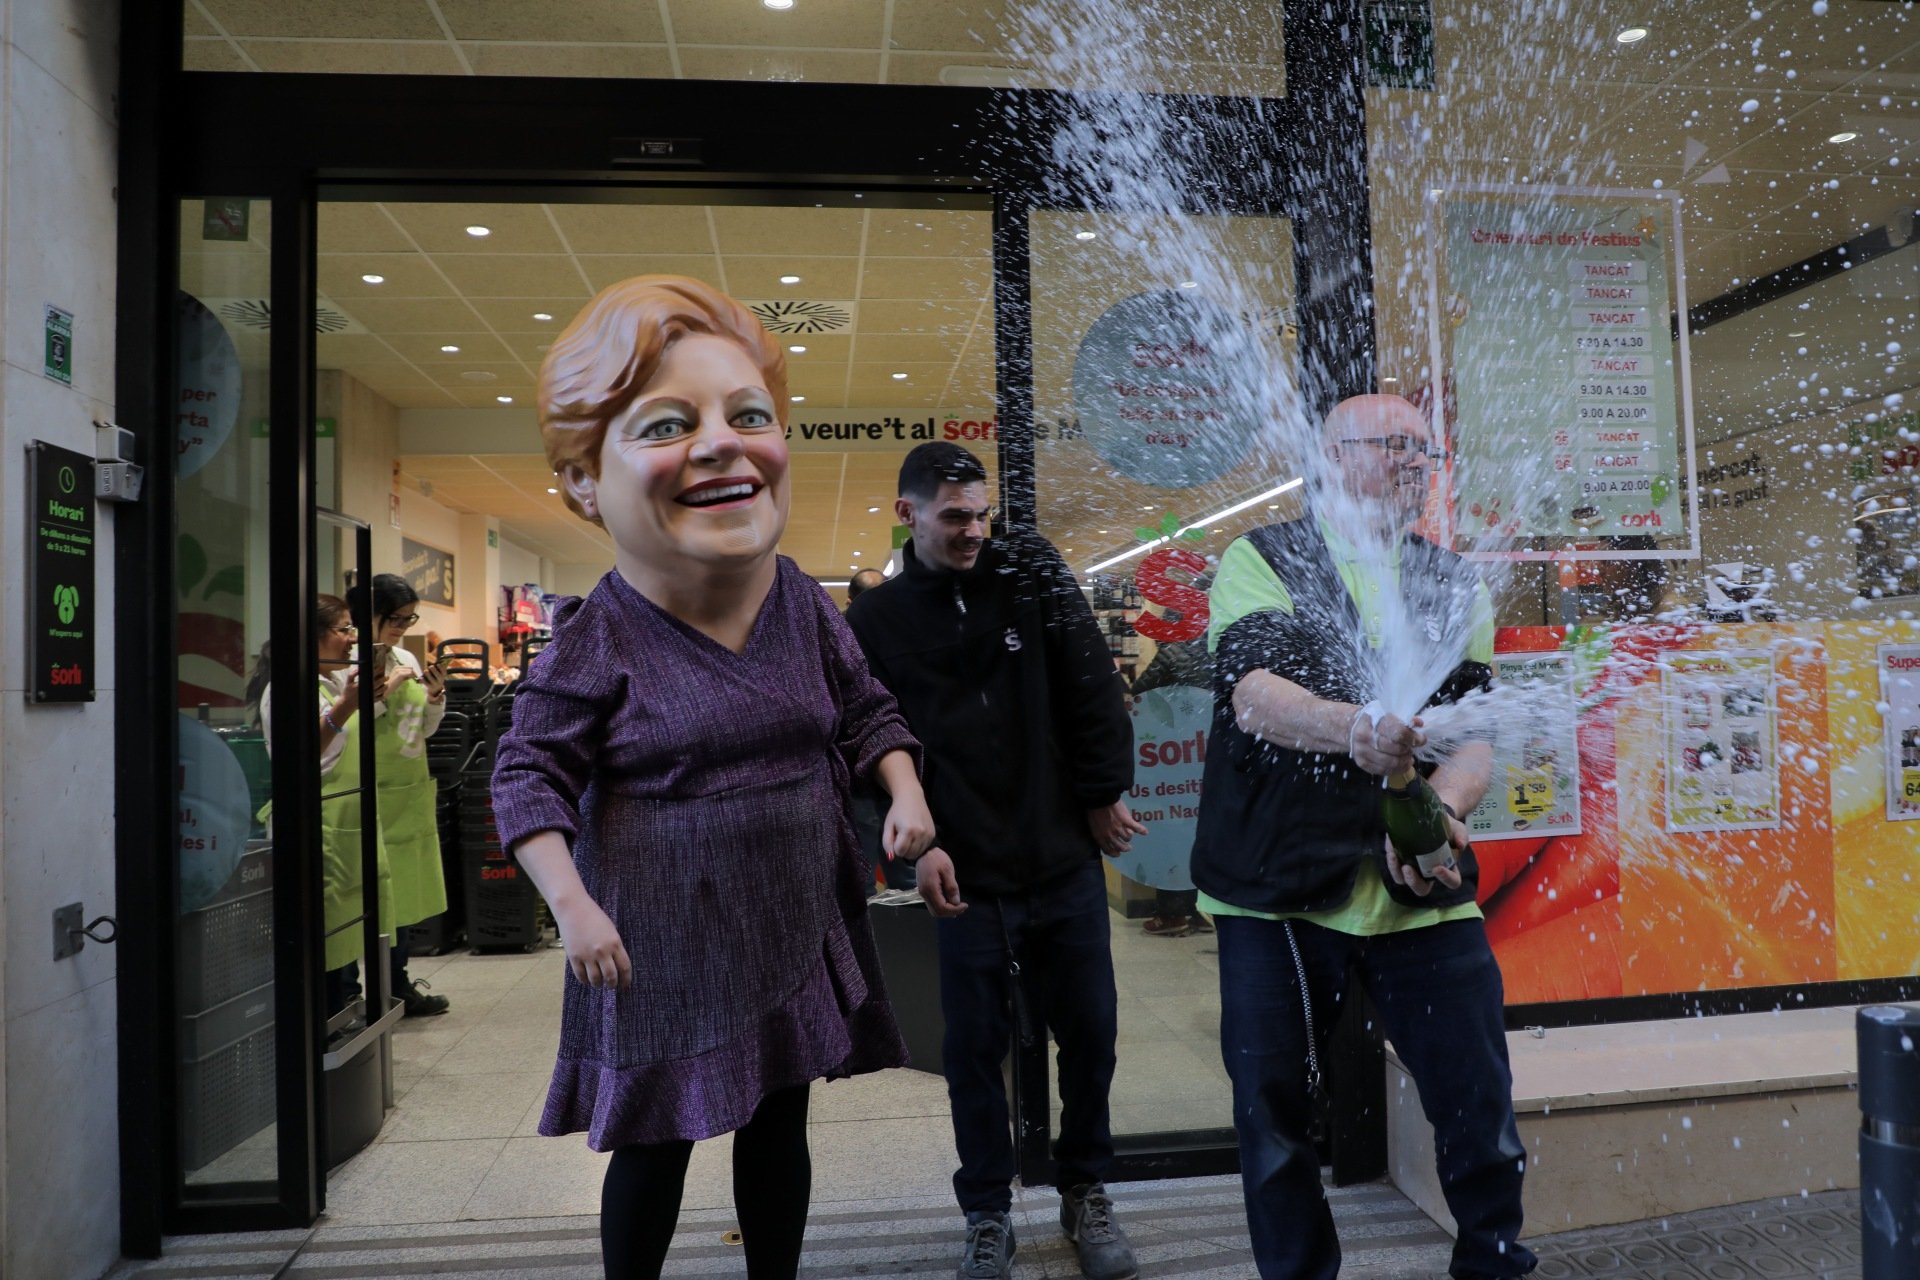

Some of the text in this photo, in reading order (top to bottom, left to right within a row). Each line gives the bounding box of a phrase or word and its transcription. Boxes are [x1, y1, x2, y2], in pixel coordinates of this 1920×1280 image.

[1584, 265, 1631, 277] TANCAT
[1587, 288, 1633, 299] TANCAT
[1589, 313, 1636, 324] TANCAT
[1603, 338, 1611, 348] A
[1615, 337, 1644, 348] 14.30
[1591, 360, 1638, 371] TANCAT
[1580, 384, 1647, 396] 9.30 A 14.30
[1581, 408, 1648, 418] 9.00 A 20.00
[911, 417, 935, 440] al
[943, 414, 999, 441] sorl
[1596, 433, 1640, 442] TANCAT
[1595, 456, 1639, 467] TANCAT
[1584, 480, 1650, 493] 9.00 A 20.00
[49, 499, 84, 521] Horari
[1621, 510, 1663, 528] sorli
[1134, 548, 1210, 643] S
[1500, 663, 1522, 672] Pinya
[51, 664, 82, 686] sorli
[1139, 730, 1208, 768] sorl
[1128, 783, 1150, 798] Us
[1131, 809, 1164, 822] bon
[211, 836, 217, 850] i
[241, 862, 265, 884] sorli
[481, 866, 517, 880] sorli
